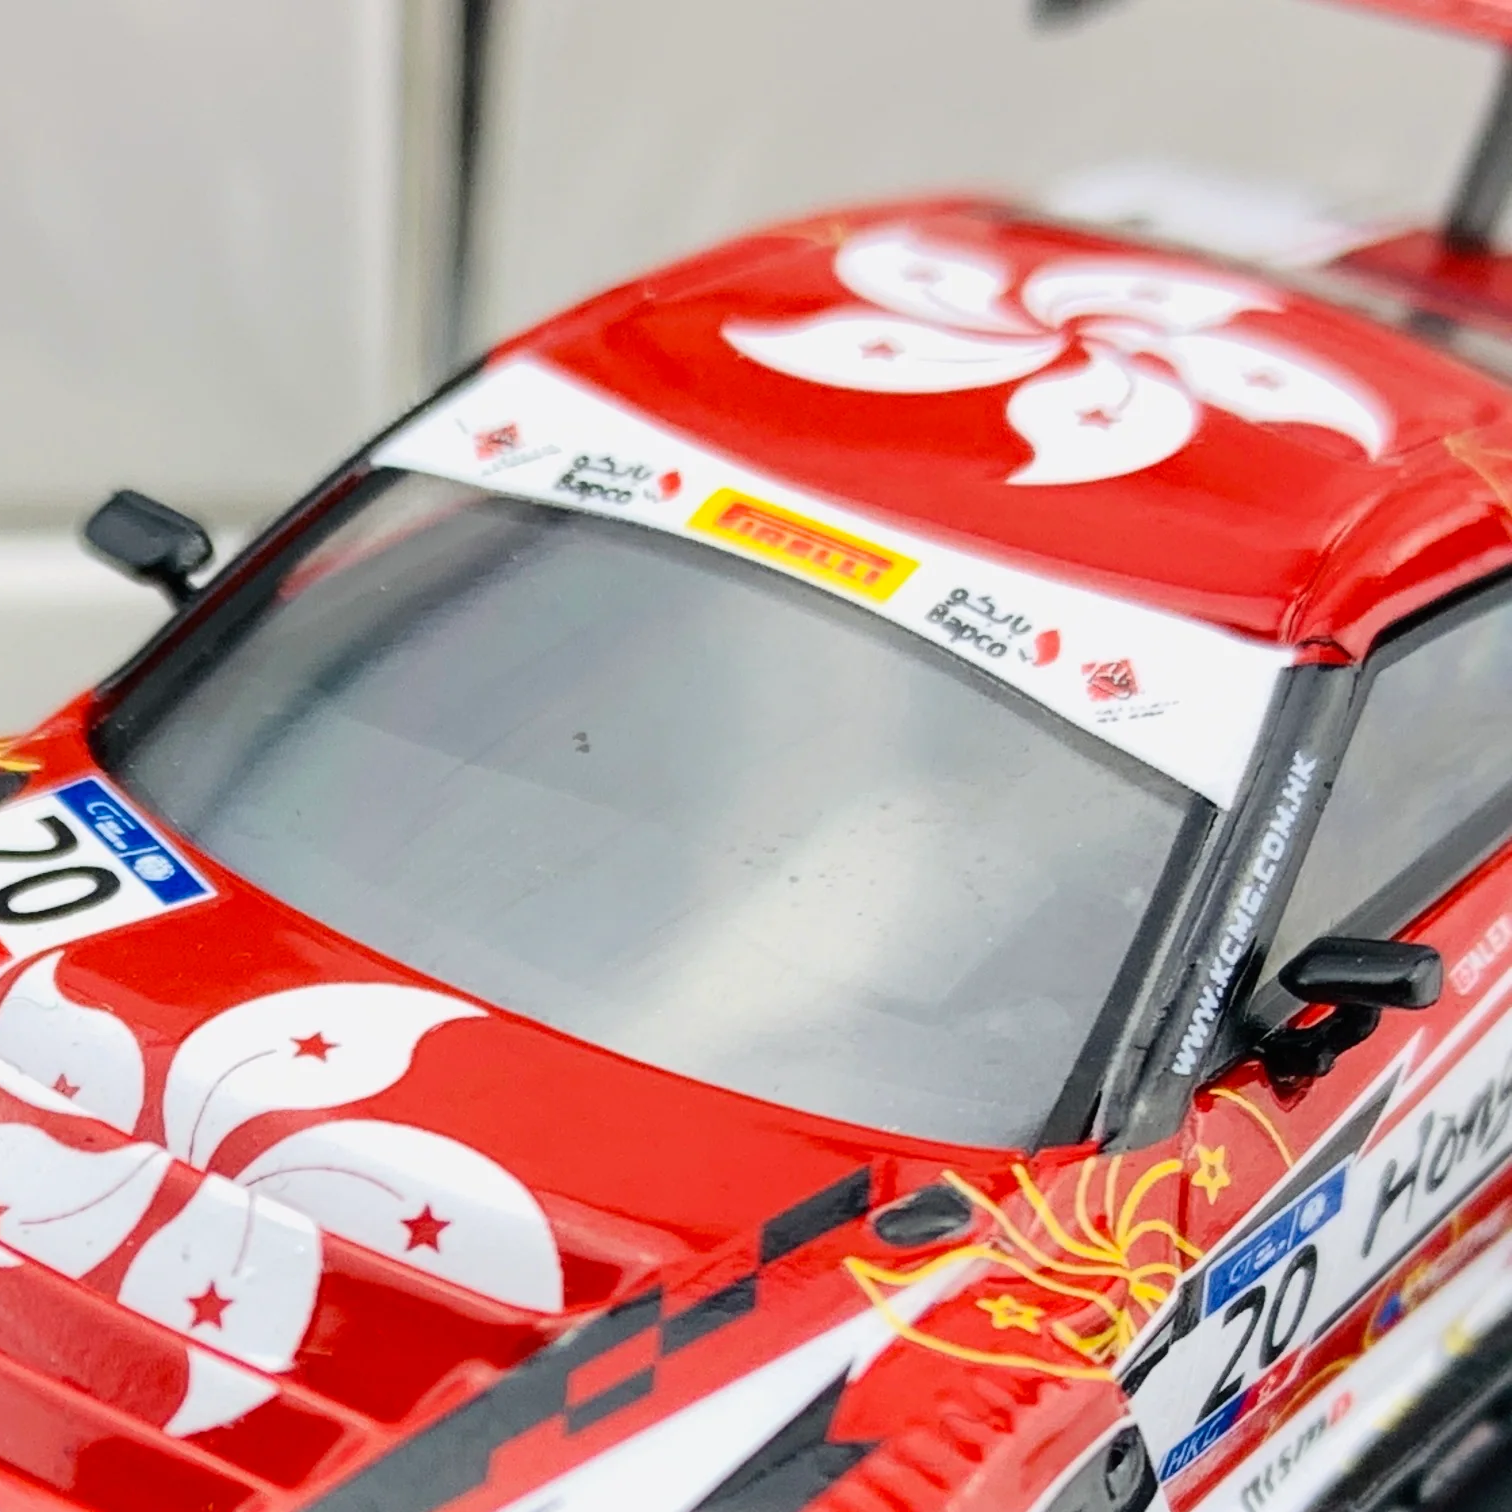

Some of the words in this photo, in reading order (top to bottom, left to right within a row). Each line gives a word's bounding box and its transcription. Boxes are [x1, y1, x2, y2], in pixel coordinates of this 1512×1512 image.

[554, 472, 634, 504] Bapco
[715, 502, 894, 587] PIRELLI
[925, 603, 1007, 659] Bapco
[1171, 749, 1318, 1076] WWW.KCMG.COM.HK
[1195, 1244, 1318, 1424] 20
[1166, 1412, 1226, 1480] HKG
